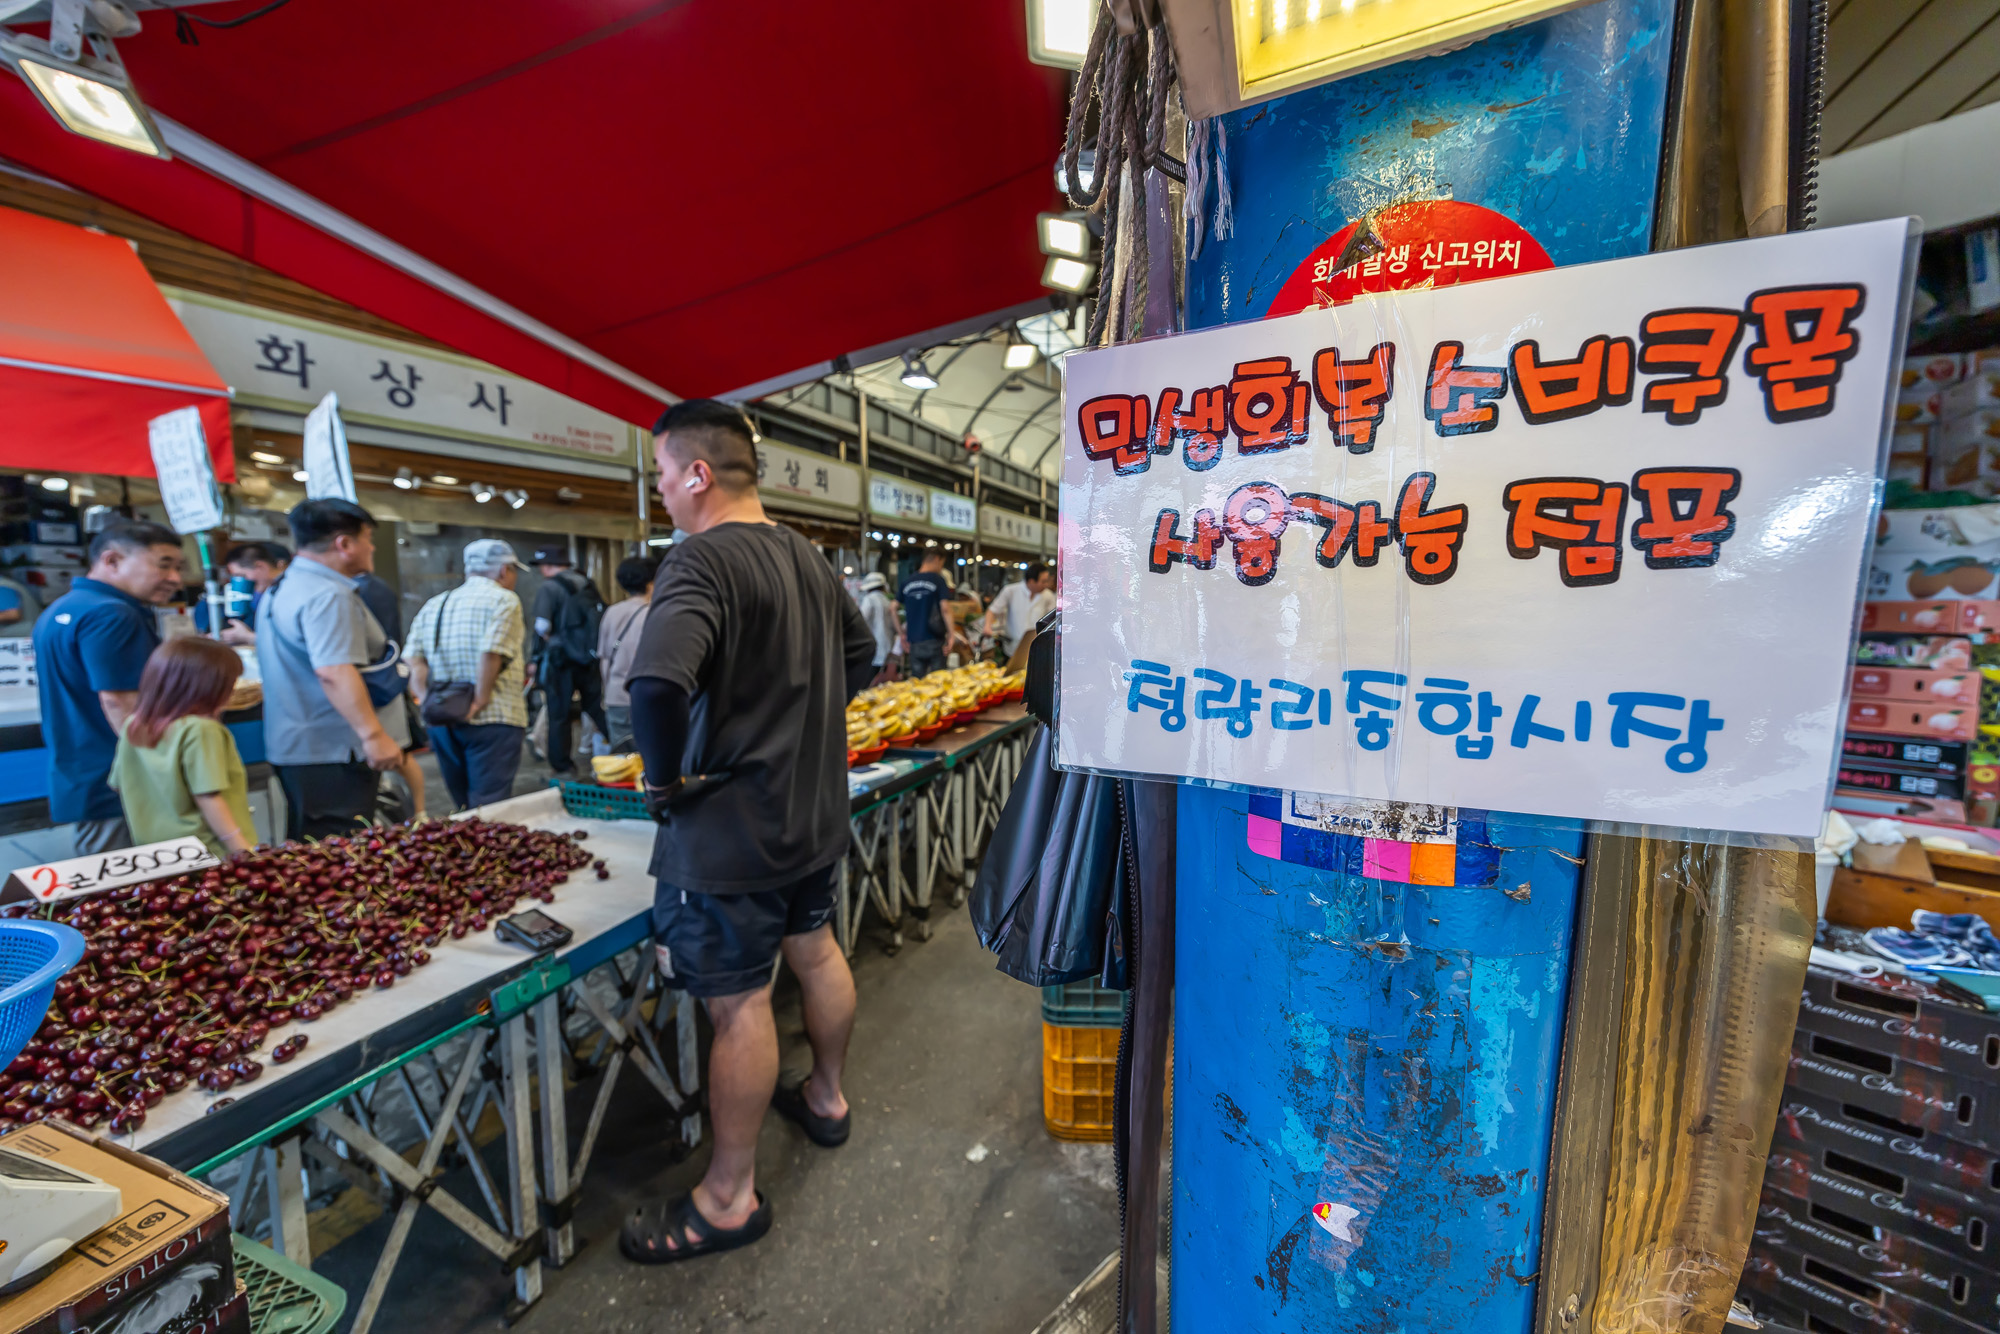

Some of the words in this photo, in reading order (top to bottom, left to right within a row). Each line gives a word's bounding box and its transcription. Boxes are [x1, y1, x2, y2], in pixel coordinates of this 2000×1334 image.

[1419, 240, 1522, 270] 신고위치
[1078, 341, 1396, 476] 민생회복
[1427, 282, 1867, 439] 소비쿠폰
[1148, 471, 1468, 586] 사용가능
[1503, 466, 1742, 588] 점포
[1125, 658, 1726, 774] 청량리종합시장
[1785, 1102, 1886, 1146] Premium
